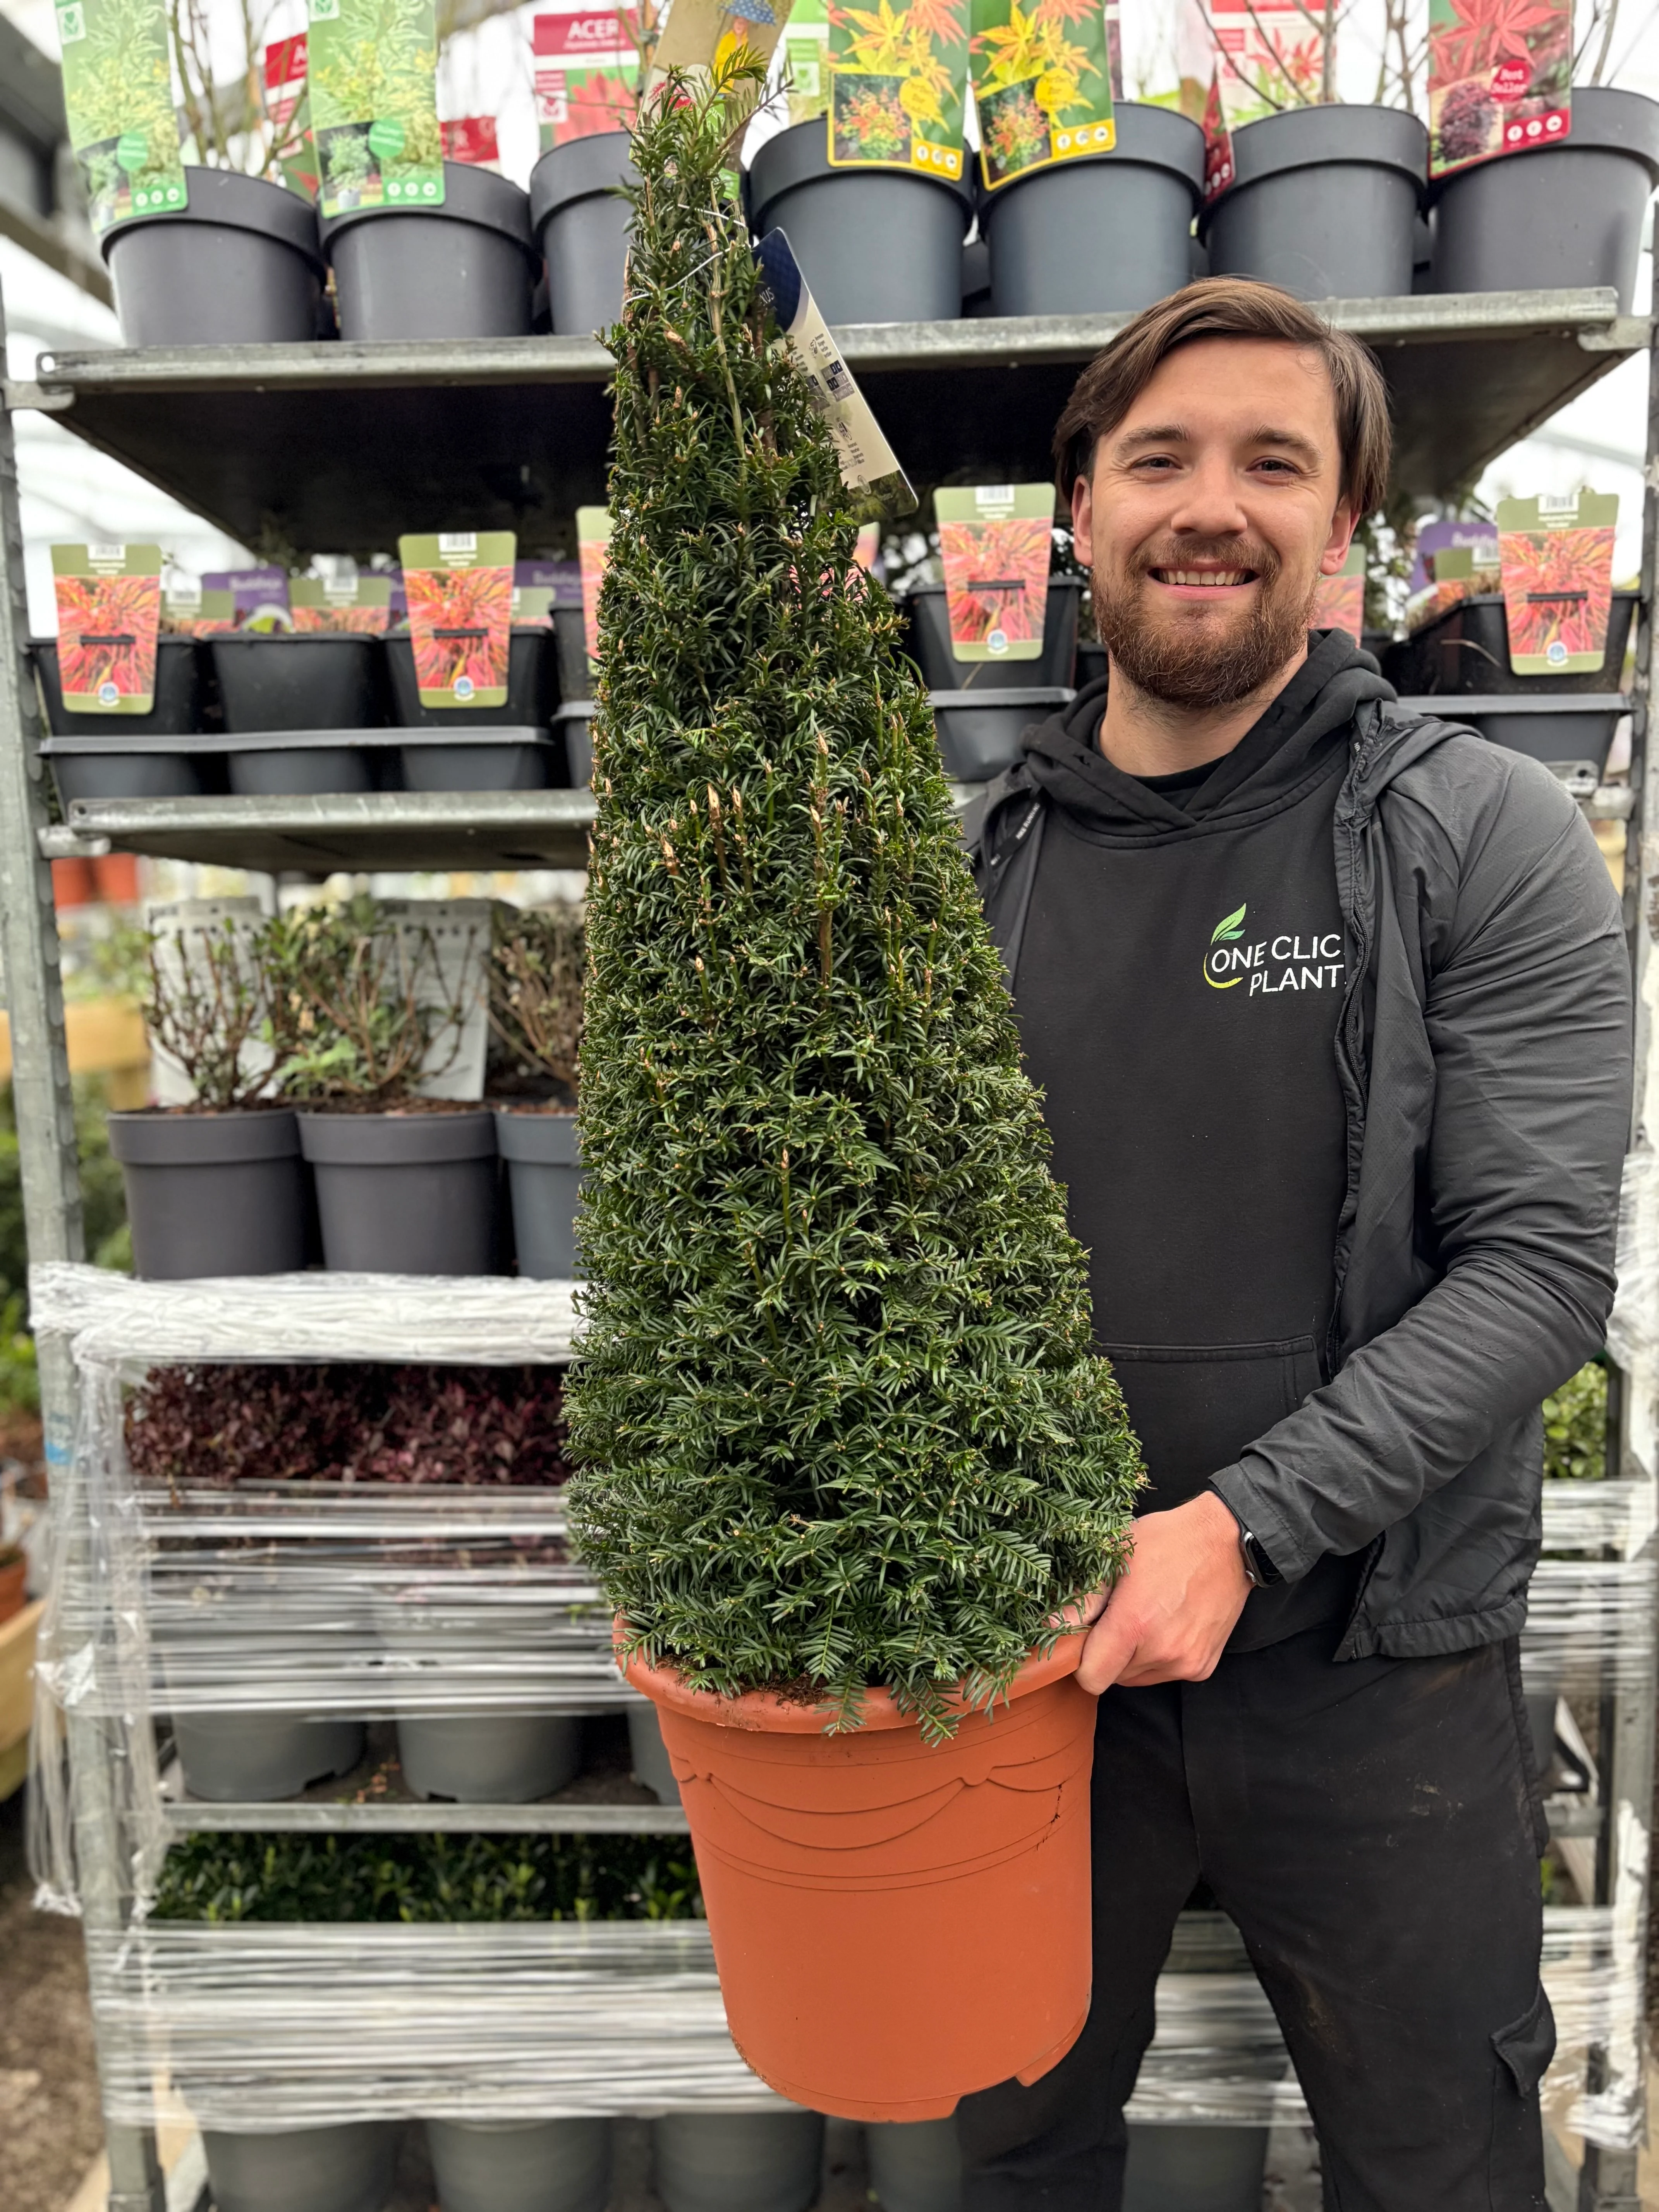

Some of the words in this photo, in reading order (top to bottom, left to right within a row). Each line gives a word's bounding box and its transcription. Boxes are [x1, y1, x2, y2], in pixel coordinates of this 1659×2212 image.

[1015, 827, 1027, 840] NIKE
[1023, 802, 1041, 828] RUNNING
[1211, 941, 1267, 973] ONE
[1271, 934, 1345, 960] CLIC
[1249, 964, 1347, 997] PLANT
